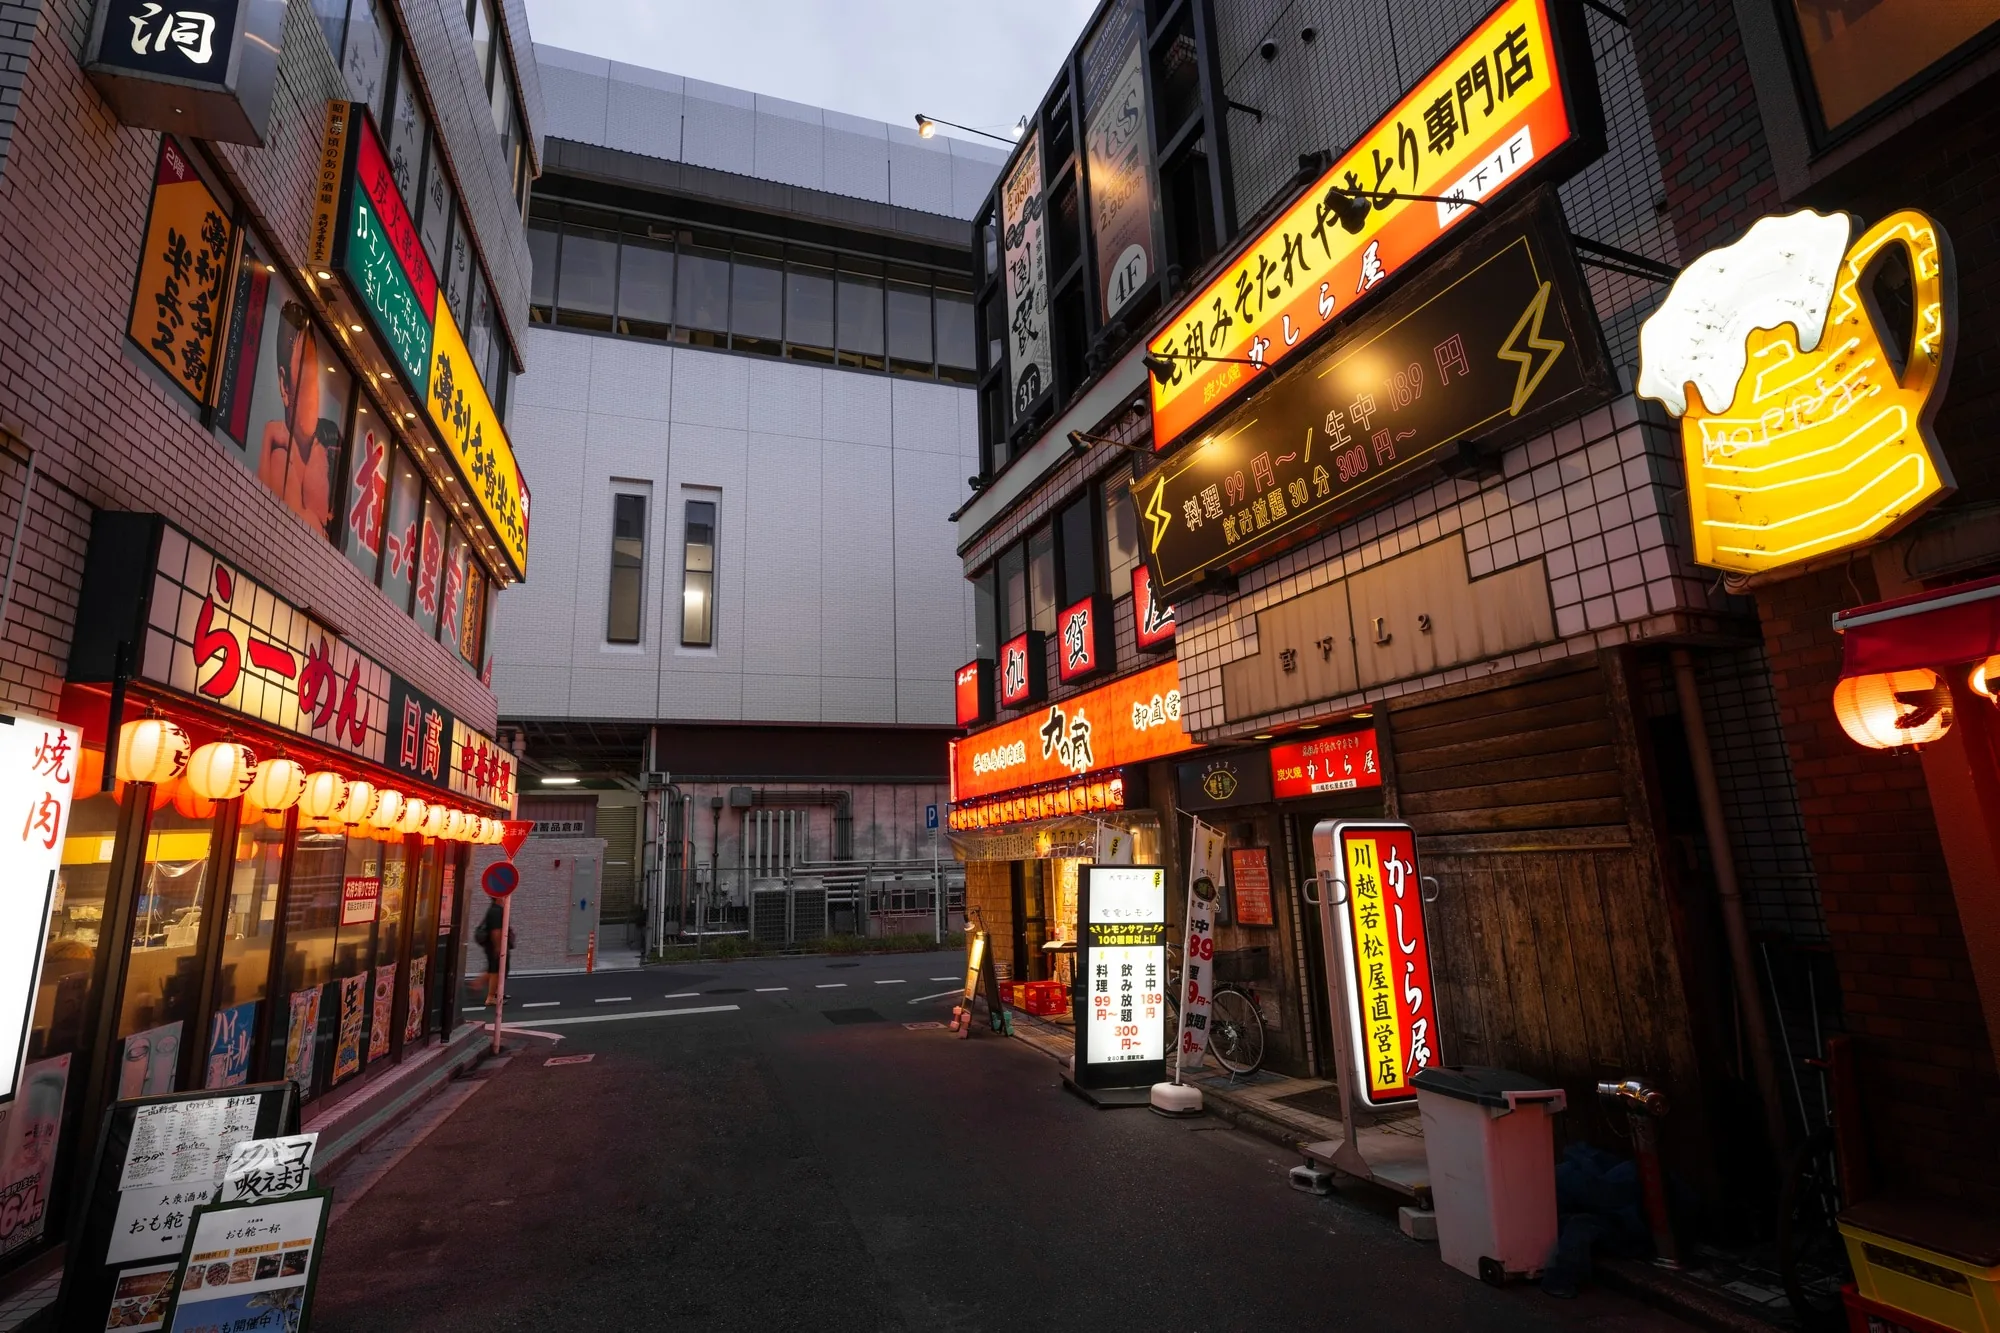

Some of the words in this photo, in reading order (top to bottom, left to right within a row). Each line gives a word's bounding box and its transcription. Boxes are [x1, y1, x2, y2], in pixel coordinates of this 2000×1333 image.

[129, 2, 217, 64] 洞
[166, 146, 185, 181] 2階
[319, 103, 344, 204] 昭和の頃のあの酒場
[1444, 136, 1525, 215] 地下1F
[1115, 253, 1141, 306] 4F
[1203, 363, 1241, 405] 炭火焼
[1249, 240, 1387, 370] かしら屋
[1019, 370, 1037, 413] 3F
[1183, 483, 1224, 532] 料理
[1225, 470, 1245, 507] 99
[1324, 392, 1377, 451] 生中
[1383, 362, 1424, 413] 189
[1433, 333, 1470, 386] 円
[1222, 487, 1288, 545] 飲み放題
[1289, 477, 1307, 508] 30
[1312, 464, 1330, 496] 分
[1336, 445, 1369, 483] 300
[1005, 646, 1026, 698] 加
[1064, 609, 1090, 671] 賀
[193, 562, 371, 748] らーめん
[400, 693, 444, 781] 日高
[460, 733, 512, 805] 中華料理
[1277, 766, 1302, 781] 炭火焼
[1306, 749, 1377, 781] かしら屋
[22, 728, 72, 850] 焼肉
[1153, 871, 1161, 888] 3F
[1103, 924, 1153, 934] レモンサワー
[1096, 963, 1109, 993] 料理
[1144, 963, 1157, 992] 生中
[1354, 844, 1397, 1086] 川越若松屋直営店
[1383, 846, 1433, 1077] かしら屋
[1094, 996, 1111, 1007] 99
[1120, 963, 1133, 1023] 飲み放題
[1140, 993, 1163, 1005] 189
[1114, 1025, 1139, 1037] 300
[1145, 1008, 1156, 1020] 円
[231, 1139, 314, 1172] タバコ
[233, 1163, 311, 1199] 吸えます
[158, 1191, 209, 1208] 大衆酒場
[128, 1211, 191, 1236] おも舵
[225, 1222, 282, 1240] おも舵一杯
